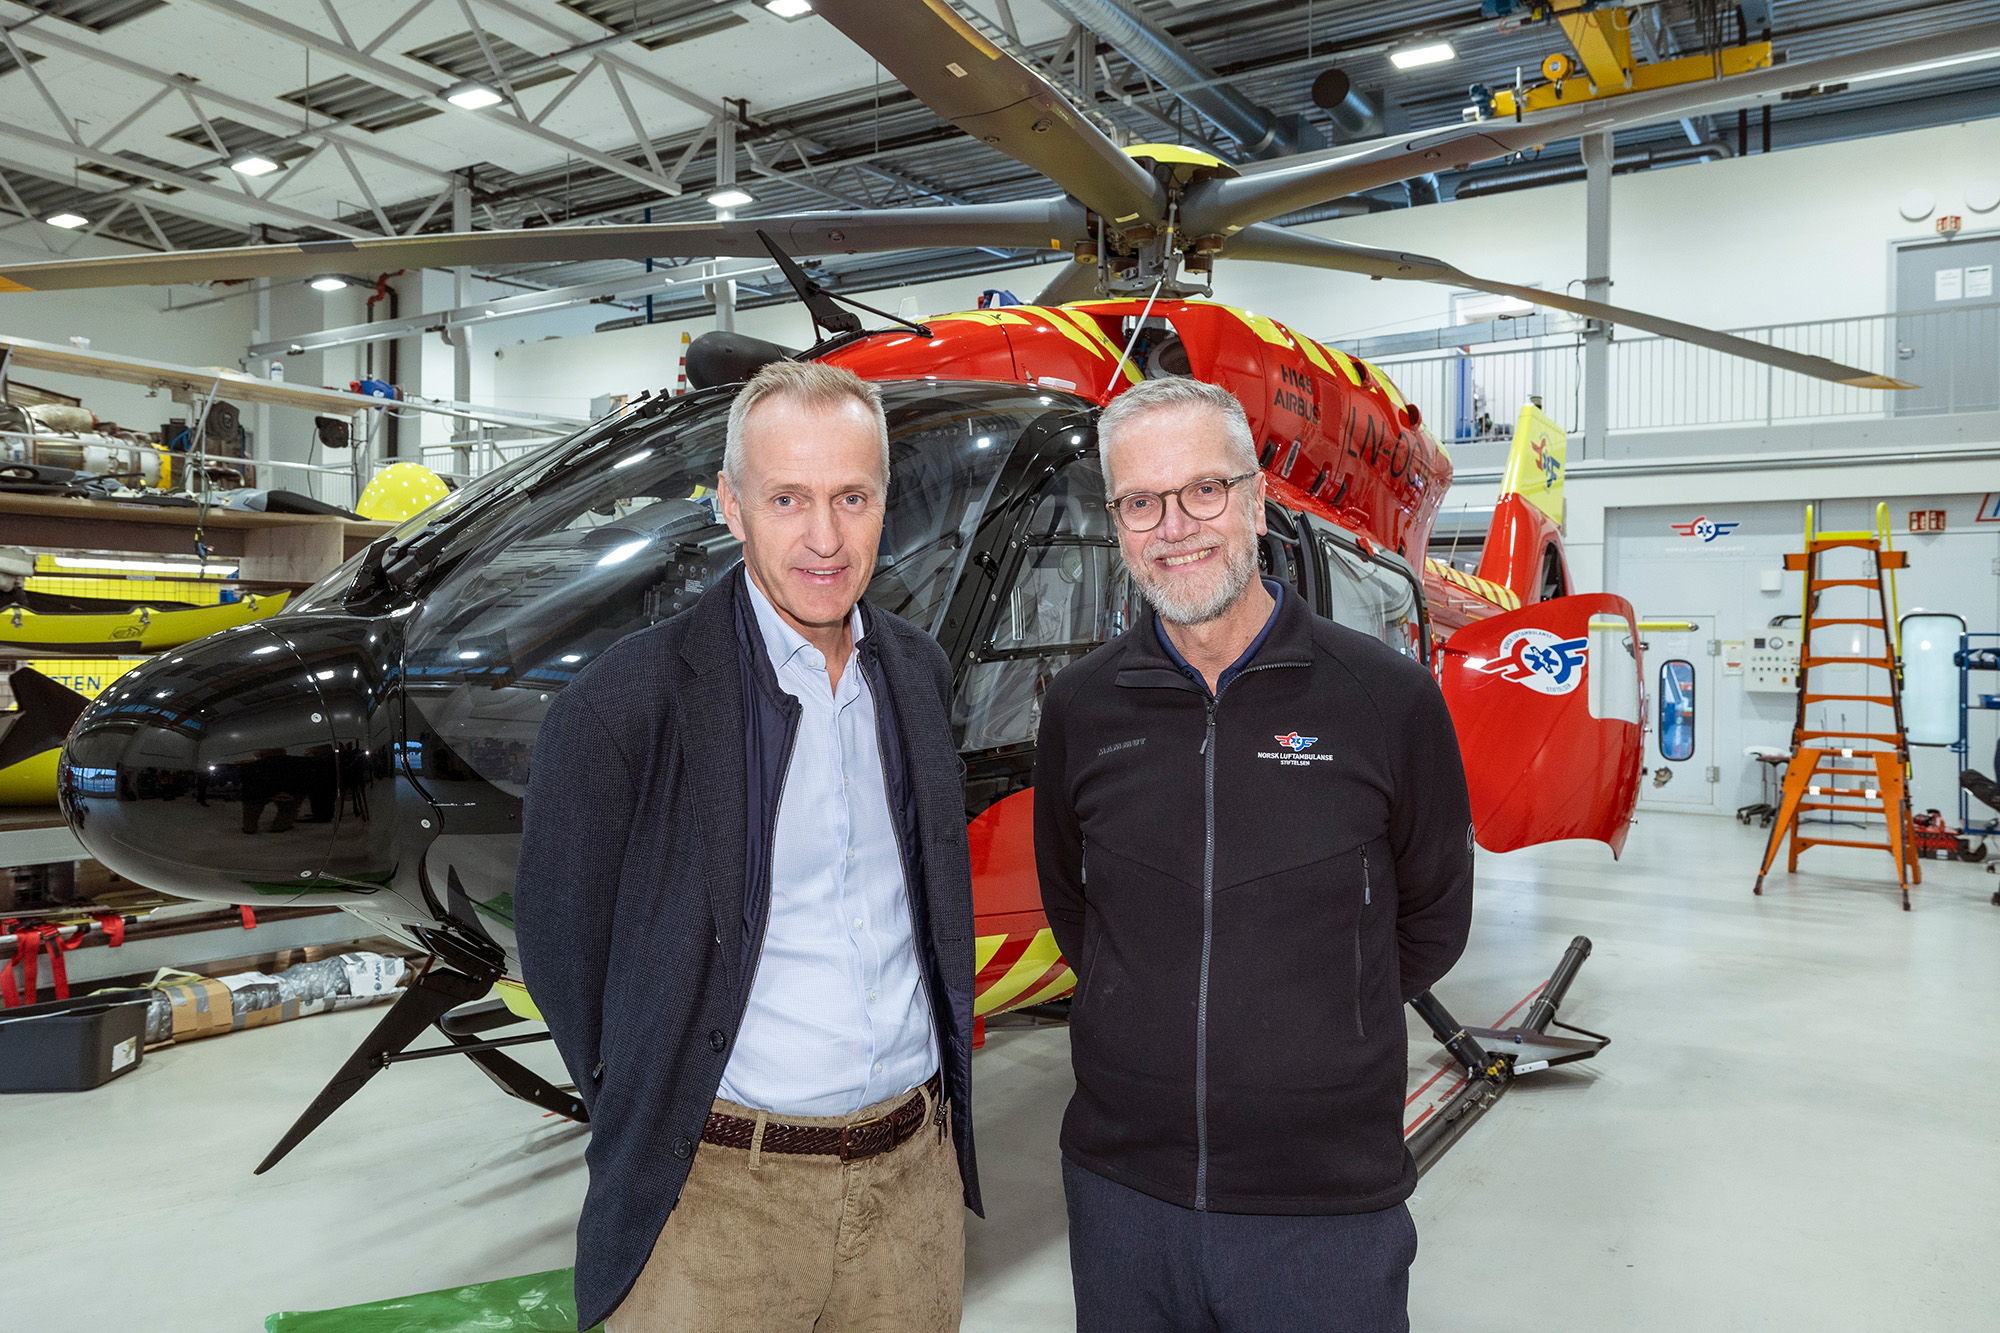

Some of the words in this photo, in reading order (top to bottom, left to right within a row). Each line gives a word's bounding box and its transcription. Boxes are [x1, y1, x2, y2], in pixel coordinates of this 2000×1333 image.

[1280, 364, 1313, 396] H145
[1274, 388, 1319, 425] AIRBUS
[1098, 737, 1147, 756] MAMMUT
[1257, 751, 1280, 760] NORSK
[1280, 752, 1334, 761] LUFTAMBULANSE
